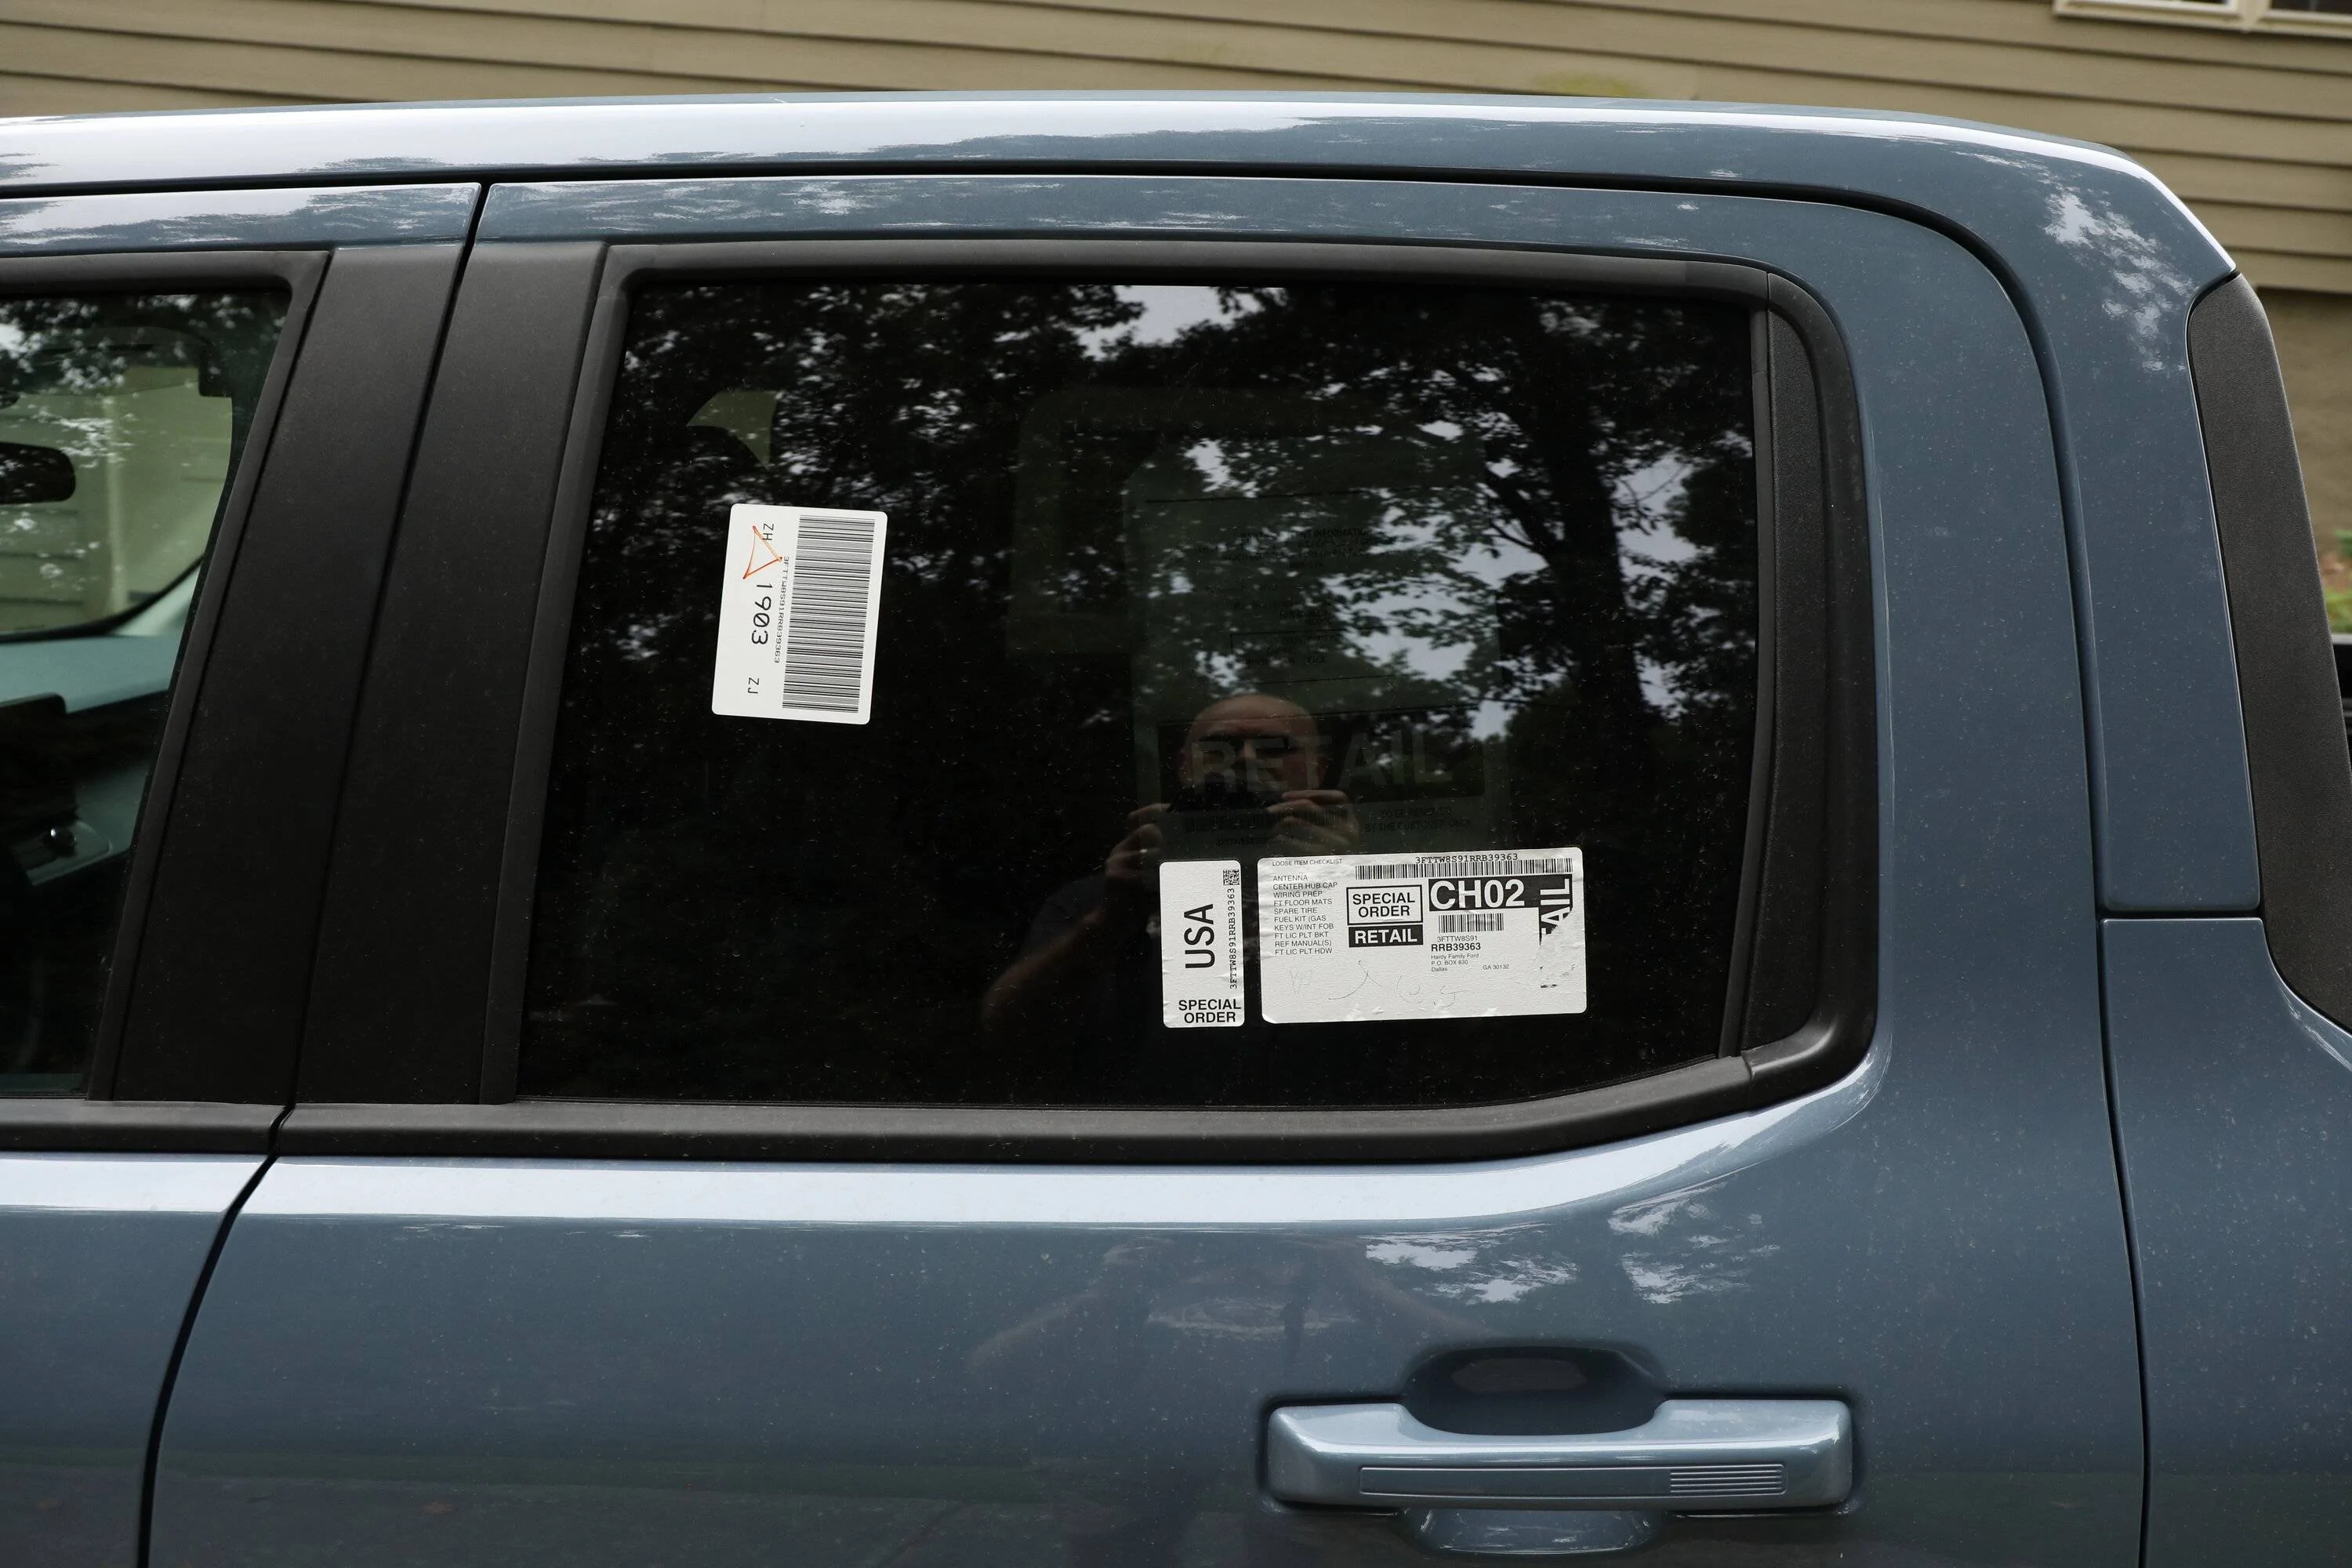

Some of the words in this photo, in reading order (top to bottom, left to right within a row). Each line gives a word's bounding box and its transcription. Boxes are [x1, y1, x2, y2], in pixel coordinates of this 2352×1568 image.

[761, 523, 775, 541] ZH
[750, 583, 773, 644] 1903
[774, 555, 790, 664] 3FTTW8S91RRB39363
[746, 677, 760, 695] ZJ
[1415, 853, 1518, 863] 3FTTW8S91RRB39363
[1352, 892, 1415, 906] SPECIAL
[1430, 879, 1525, 910] CH02
[1358, 905, 1410, 918] ORDER
[1540, 878, 1570, 935] AIL
[1183, 903, 1215, 969] USA
[1227, 888, 1237, 989] 3FTTW8S91RRB39363
[1355, 928, 1417, 944] RETAIL
[1431, 942, 1481, 952] RRB39363
[1178, 998, 1241, 1011] SPECIAL
[1184, 1011, 1236, 1024] ORDER
